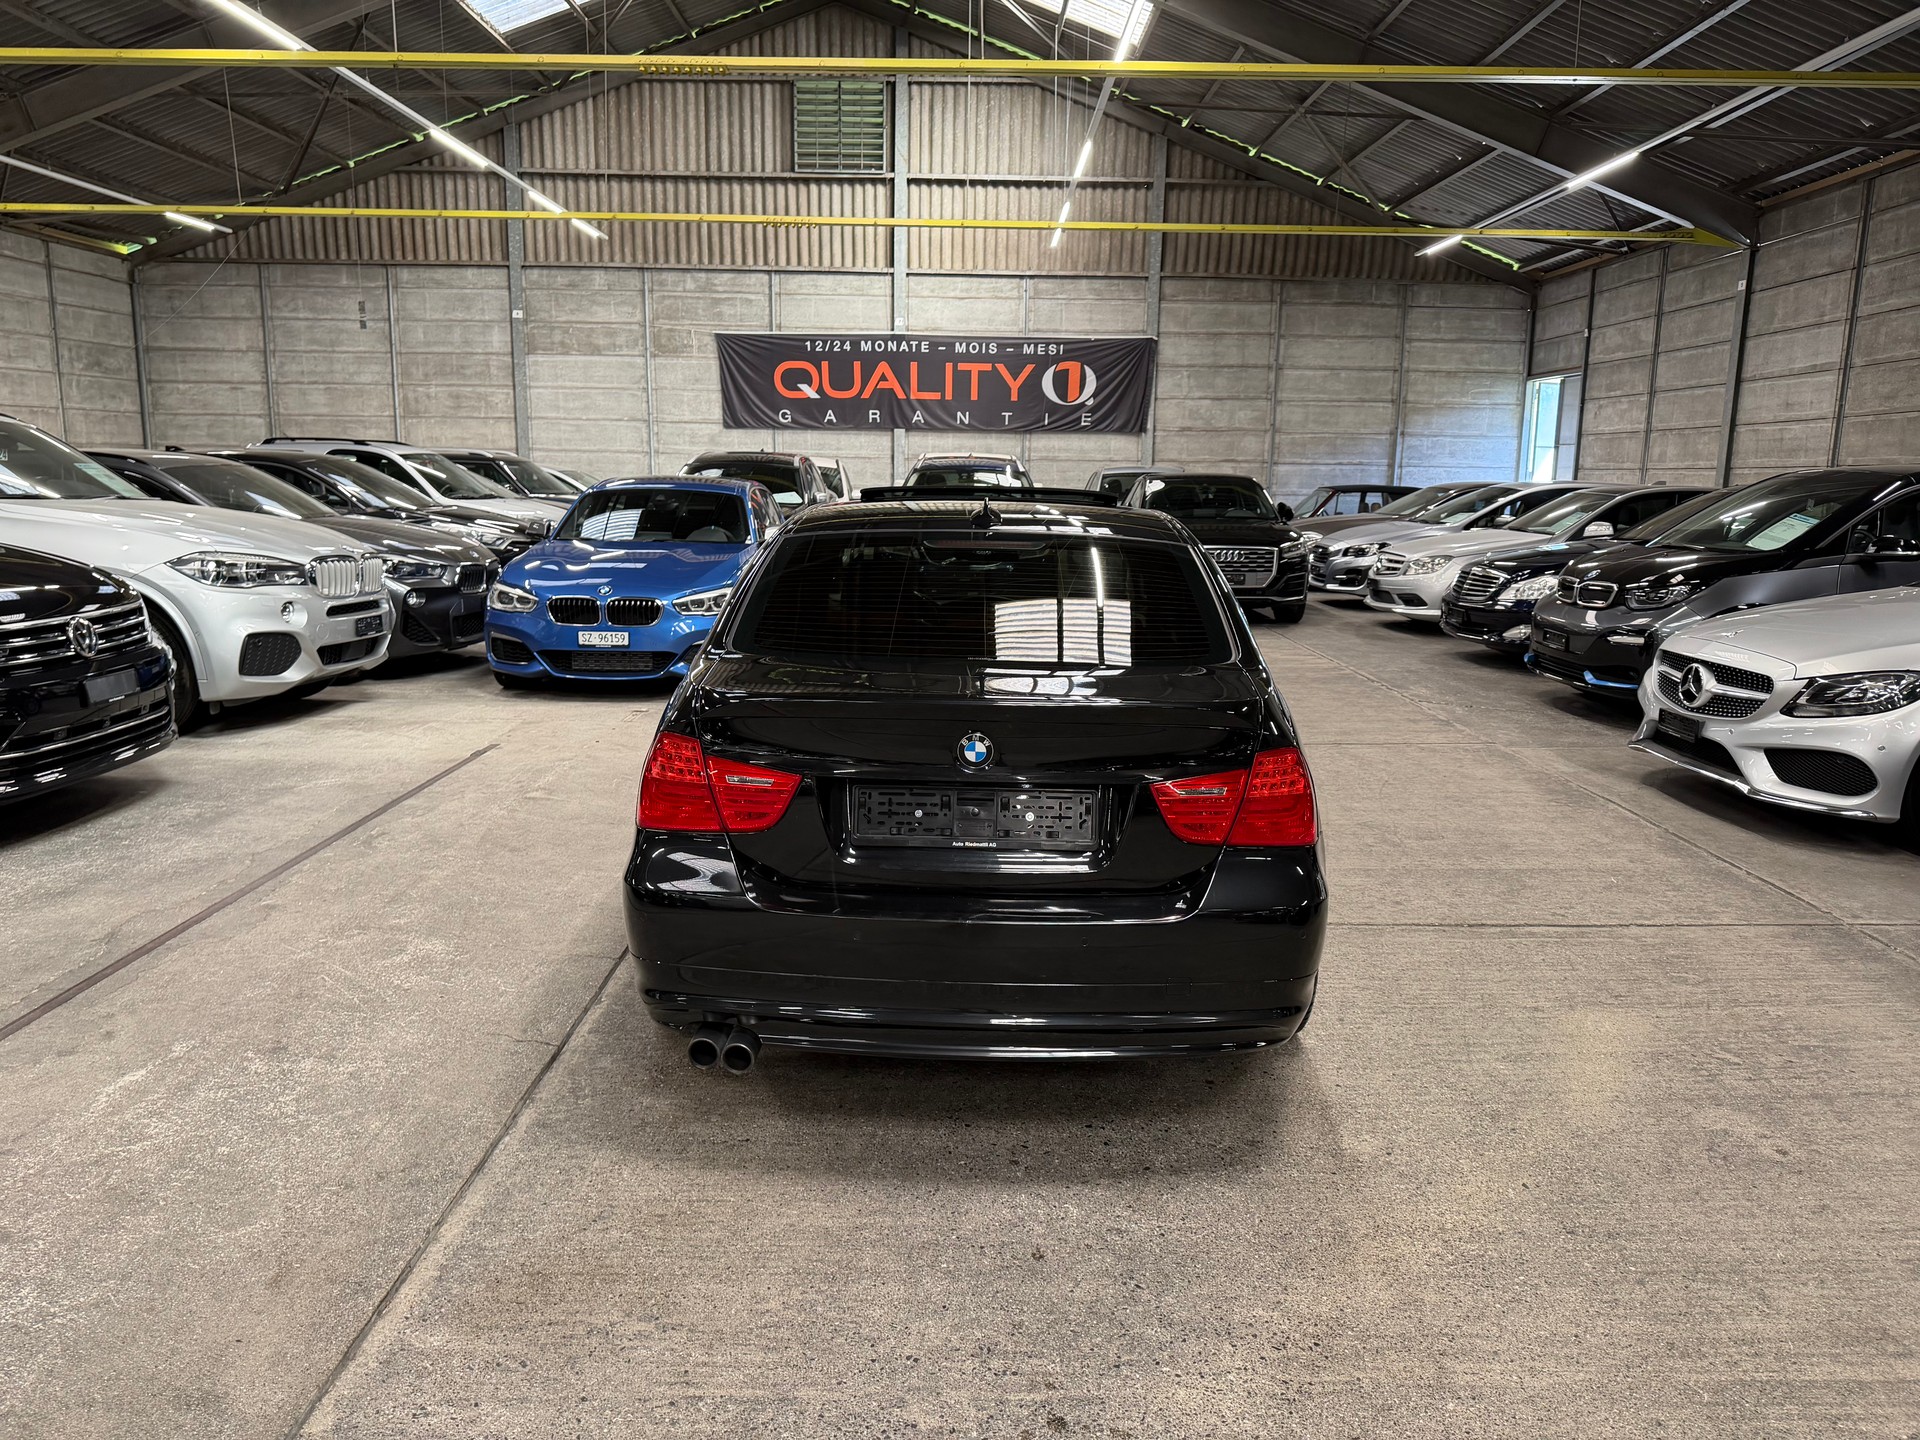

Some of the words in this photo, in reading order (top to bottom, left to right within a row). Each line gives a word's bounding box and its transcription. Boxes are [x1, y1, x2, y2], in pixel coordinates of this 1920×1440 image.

[804, 340, 852, 352] 12/24
[860, 340, 930, 353] MONATE
[955, 342, 998, 354] MOIS
[1023, 343, 1064, 355] MESI
[773, 360, 1036, 402] QUALITY
[778, 409, 1092, 426] GARANTIE
[961, 735, 991, 746] BMW
